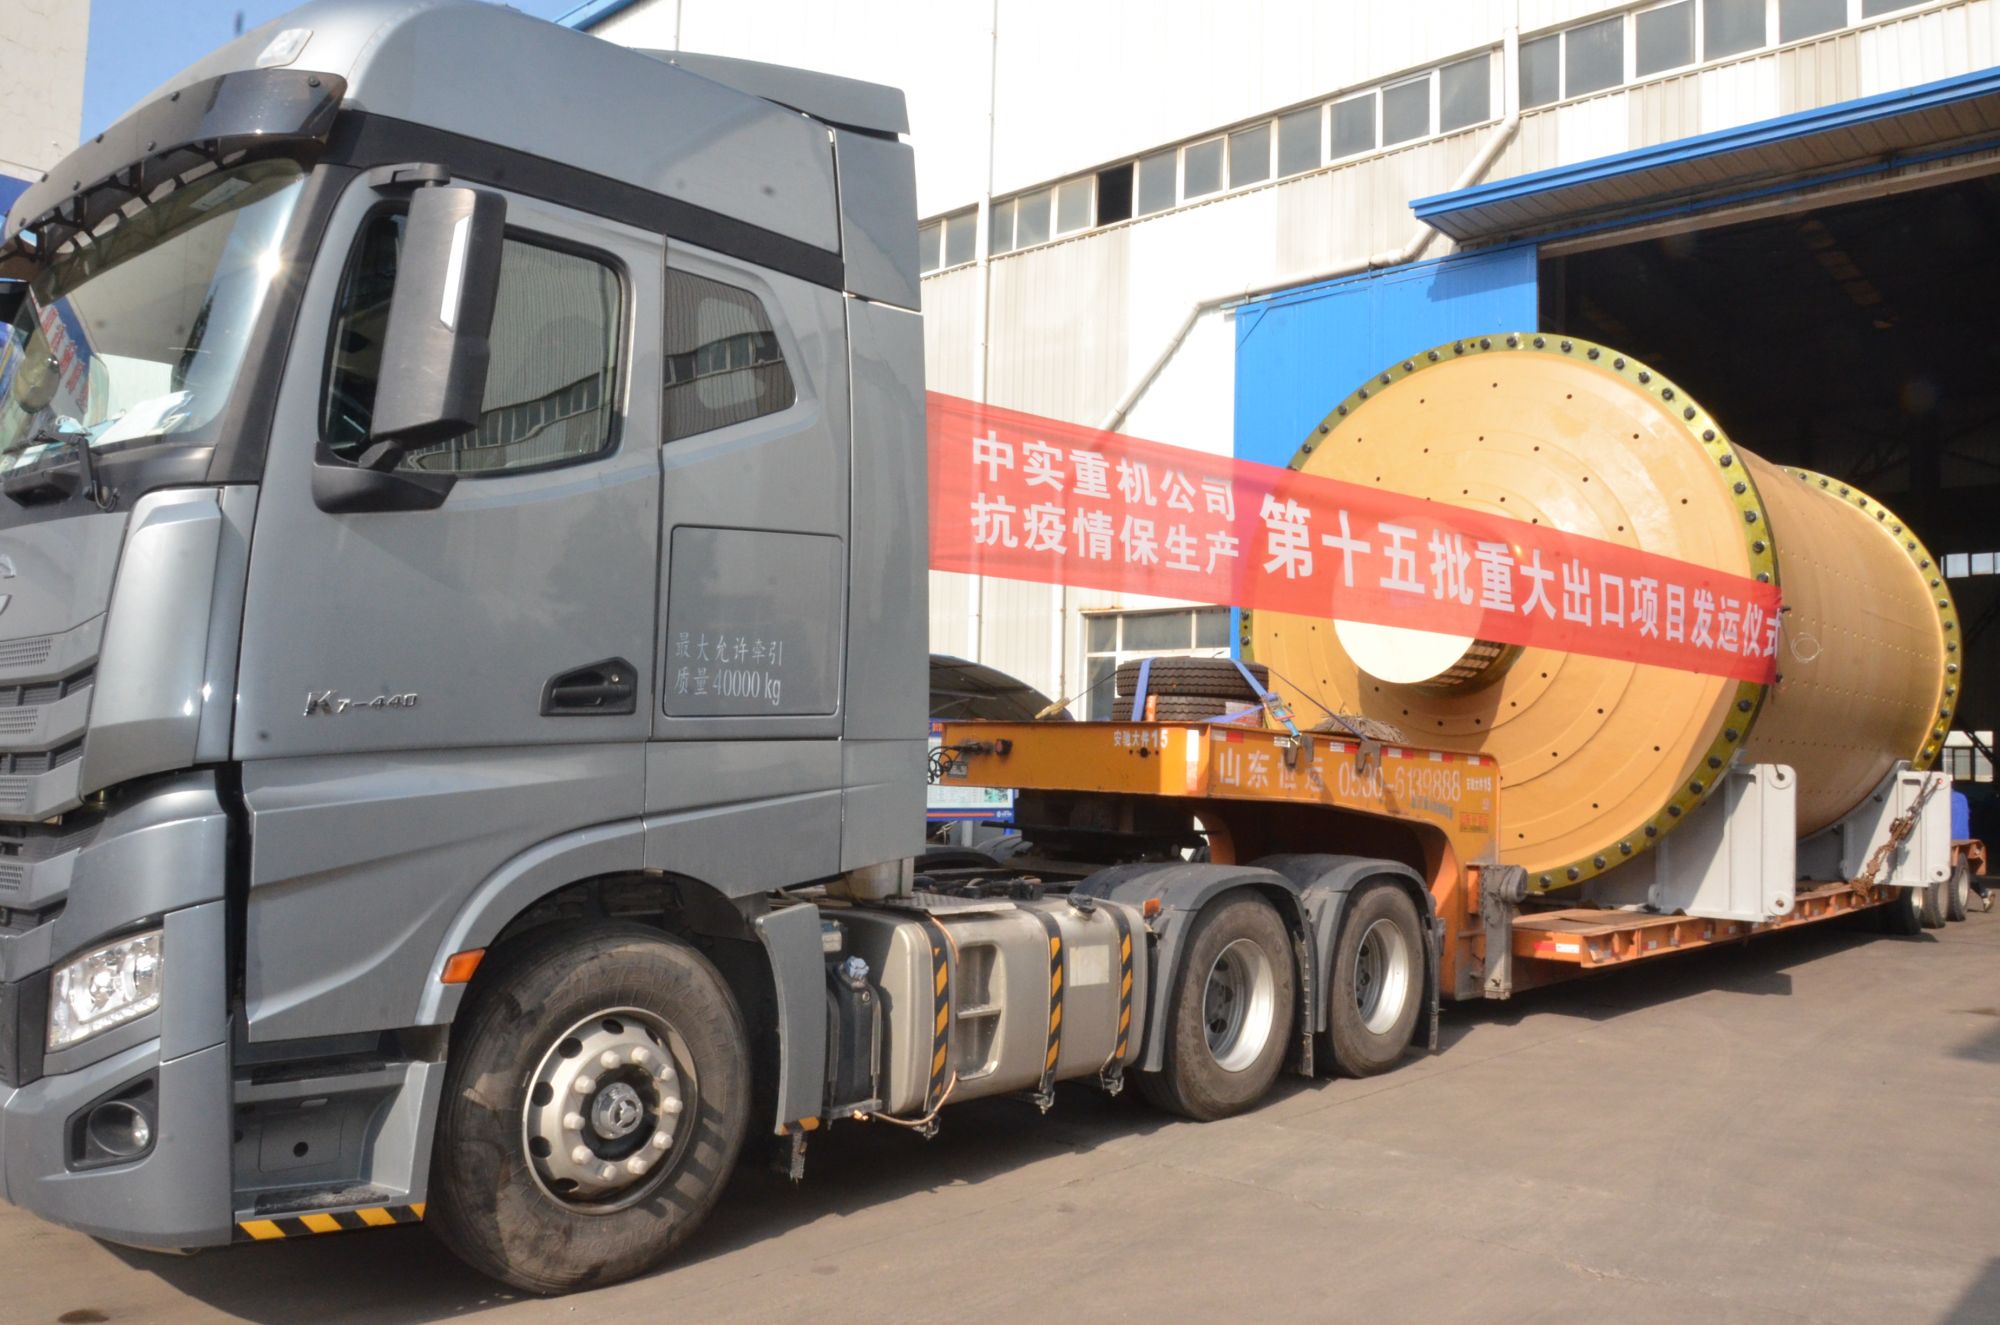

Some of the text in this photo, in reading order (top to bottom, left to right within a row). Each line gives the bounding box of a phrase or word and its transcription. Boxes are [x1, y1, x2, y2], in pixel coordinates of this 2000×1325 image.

[972, 430, 1236, 522] 中实重机公司
[970, 493, 1240, 574] 抗疫情保生产
[1258, 493, 1782, 659] 第十五批重大出口项目发运仪式
[674, 632, 784, 667] 最大允许牵引
[764, 671, 782, 706] kg
